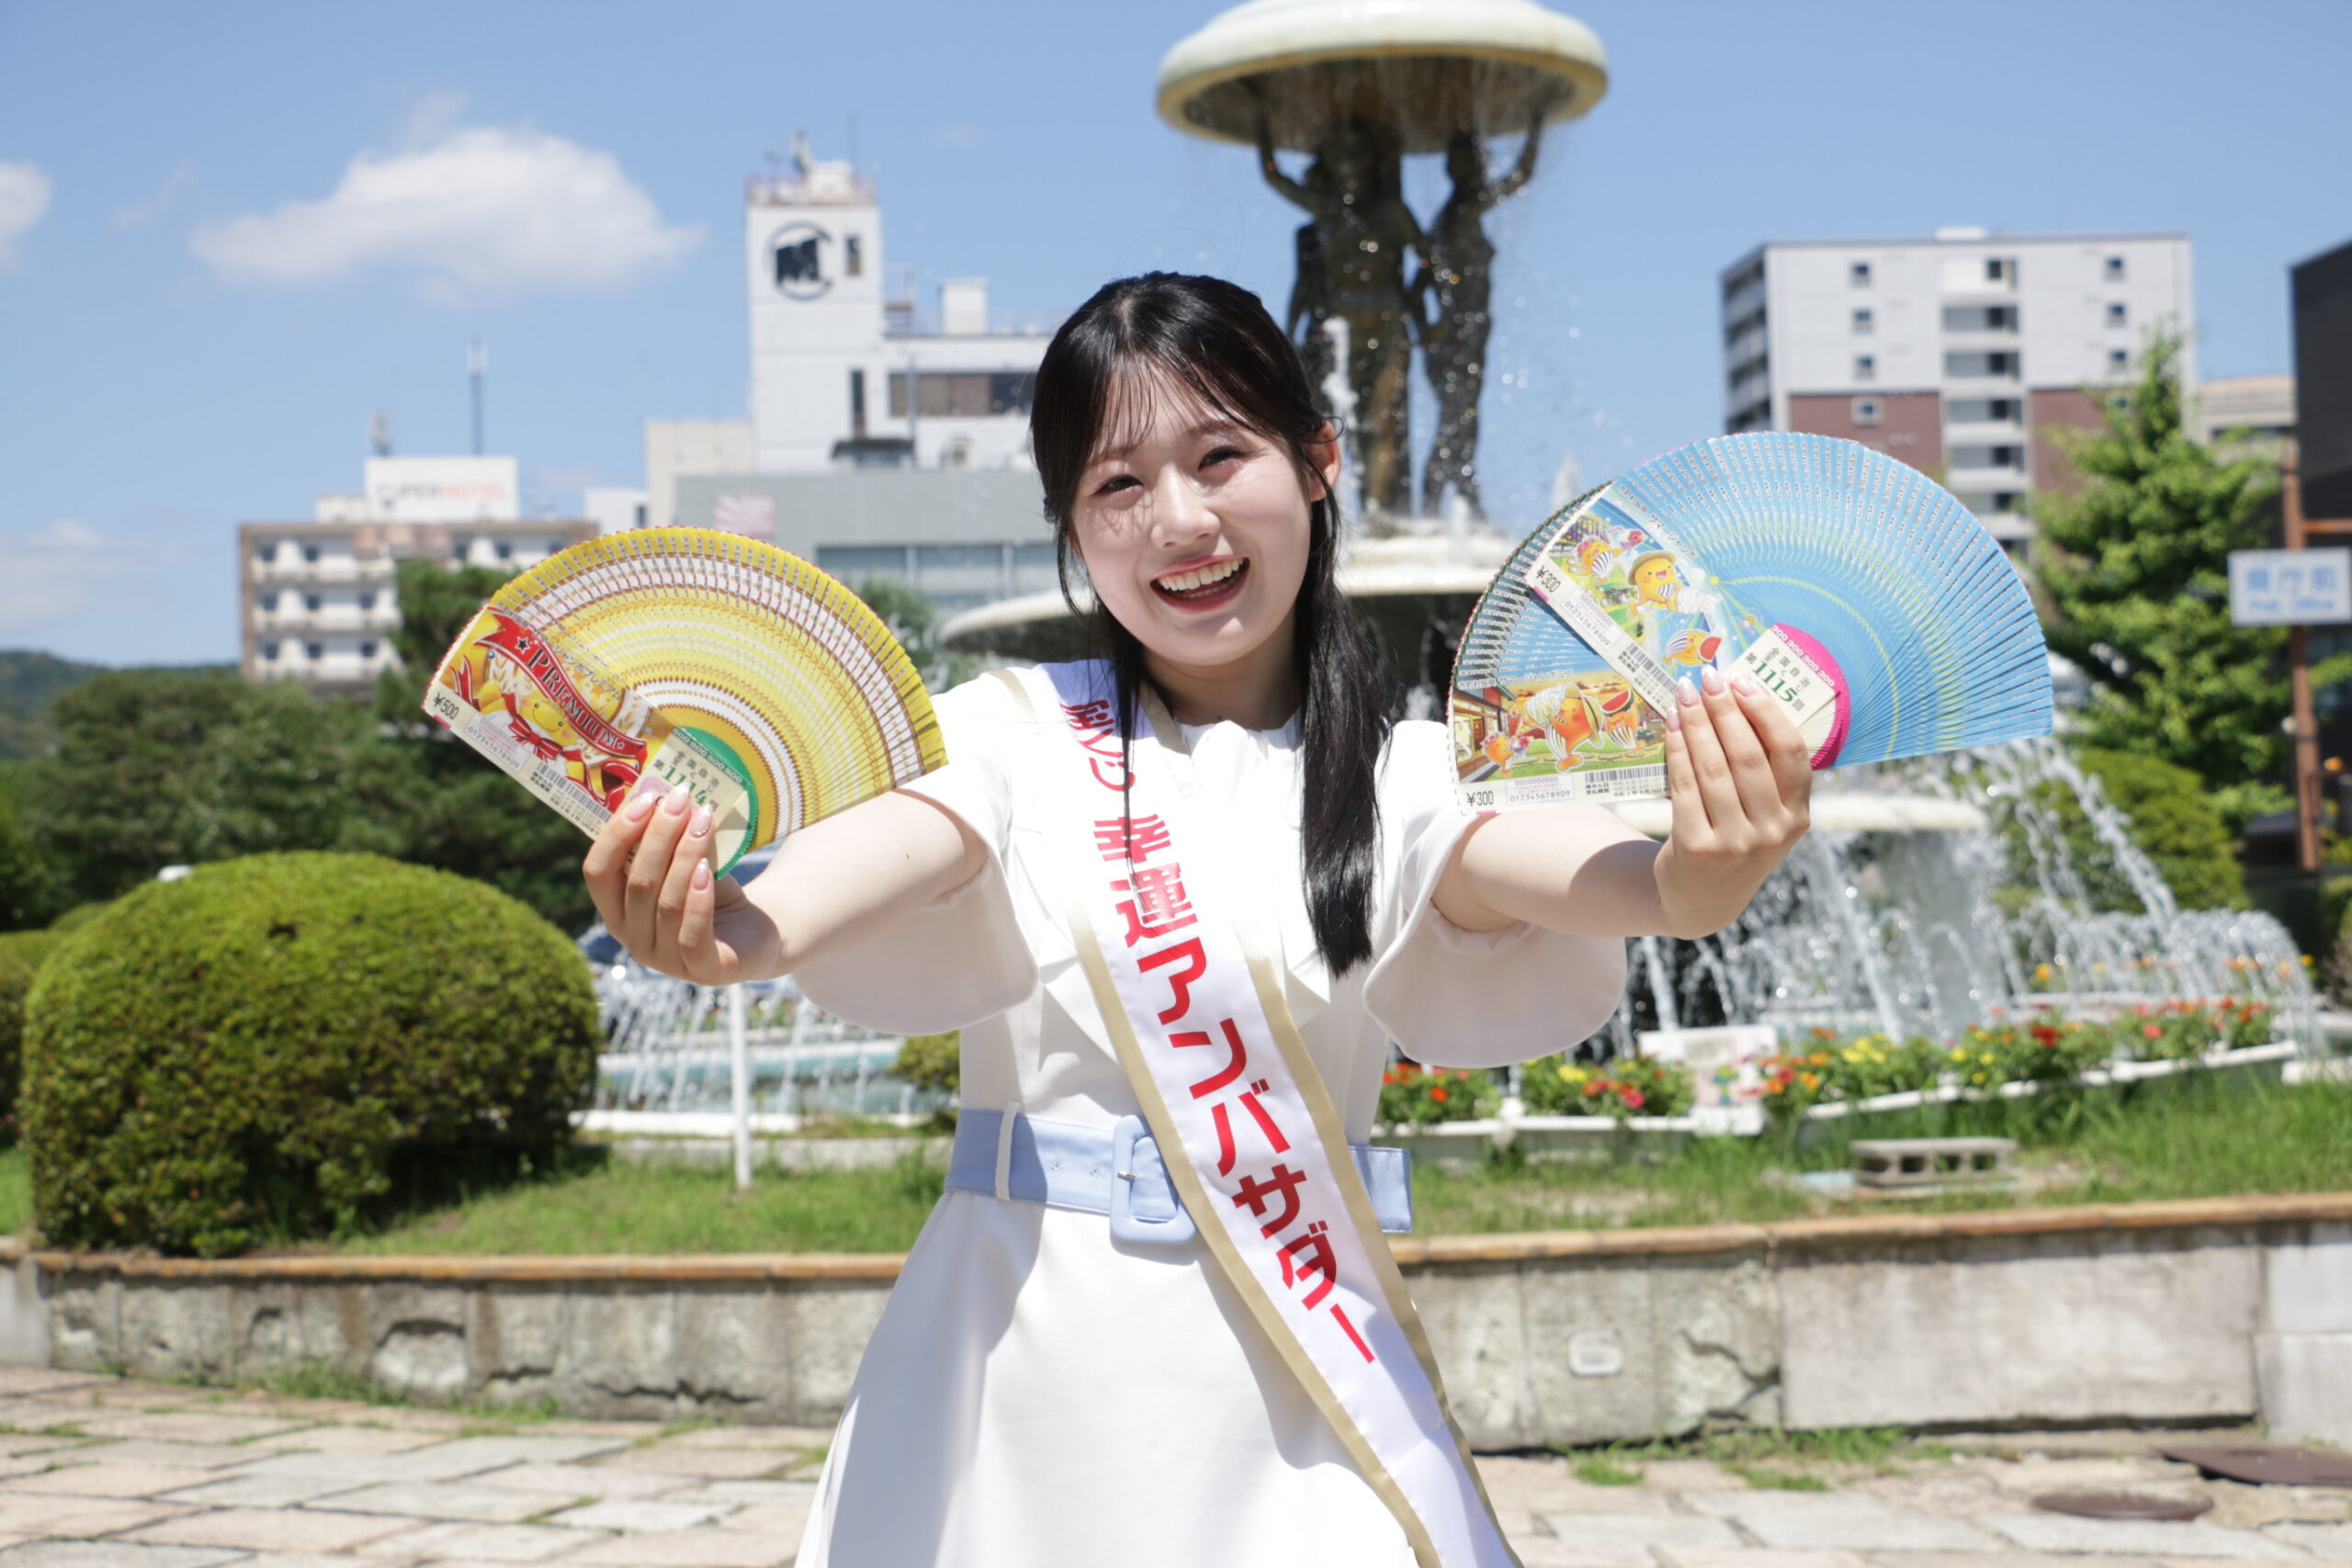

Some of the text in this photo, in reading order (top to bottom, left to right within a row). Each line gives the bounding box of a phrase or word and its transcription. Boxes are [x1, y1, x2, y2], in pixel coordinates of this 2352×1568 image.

[1535, 564, 1562, 593] ¥300
[1564, 600, 1611, 647] 012345678909
[1770, 624, 1836, 687] 300 300 300 300
[527, 648, 619, 750] PREMIUM
[1744, 652, 1805, 712] 第1115回
[432, 692, 460, 722] ¥500
[690, 741, 708, 758] 500
[707, 753, 725, 770] 500
[724, 768, 743, 784] 500
[1466, 789, 1494, 807] ¥300
[1509, 790, 1572, 804] 012345678909
